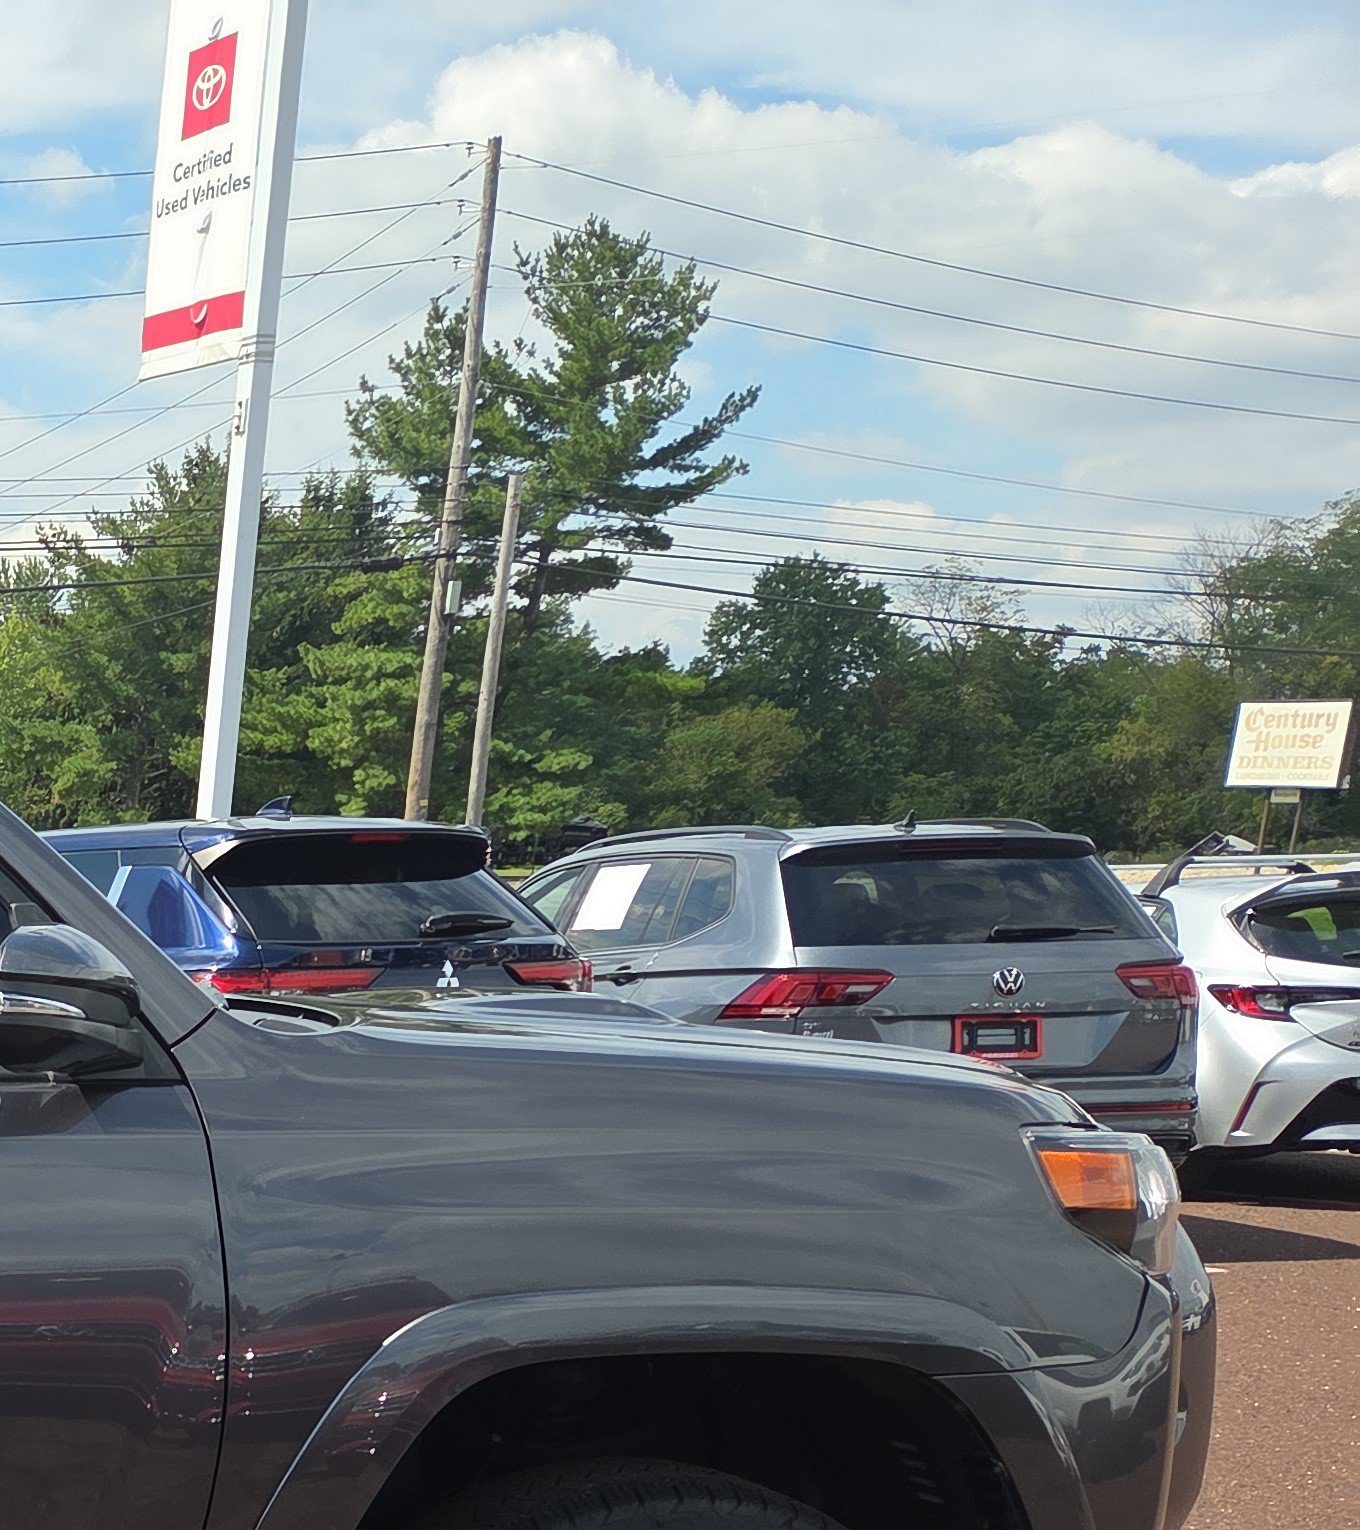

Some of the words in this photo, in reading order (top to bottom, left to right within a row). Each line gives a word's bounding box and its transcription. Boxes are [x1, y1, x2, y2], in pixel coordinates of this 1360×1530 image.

[173, 142, 233, 183] Certified
[156, 189, 189, 218] Used
[192, 173, 251, 205] Vehicles
[1244, 706, 1339, 734] Century
[1246, 731, 1325, 752] House
[1236, 755, 1335, 770] DINNERS
